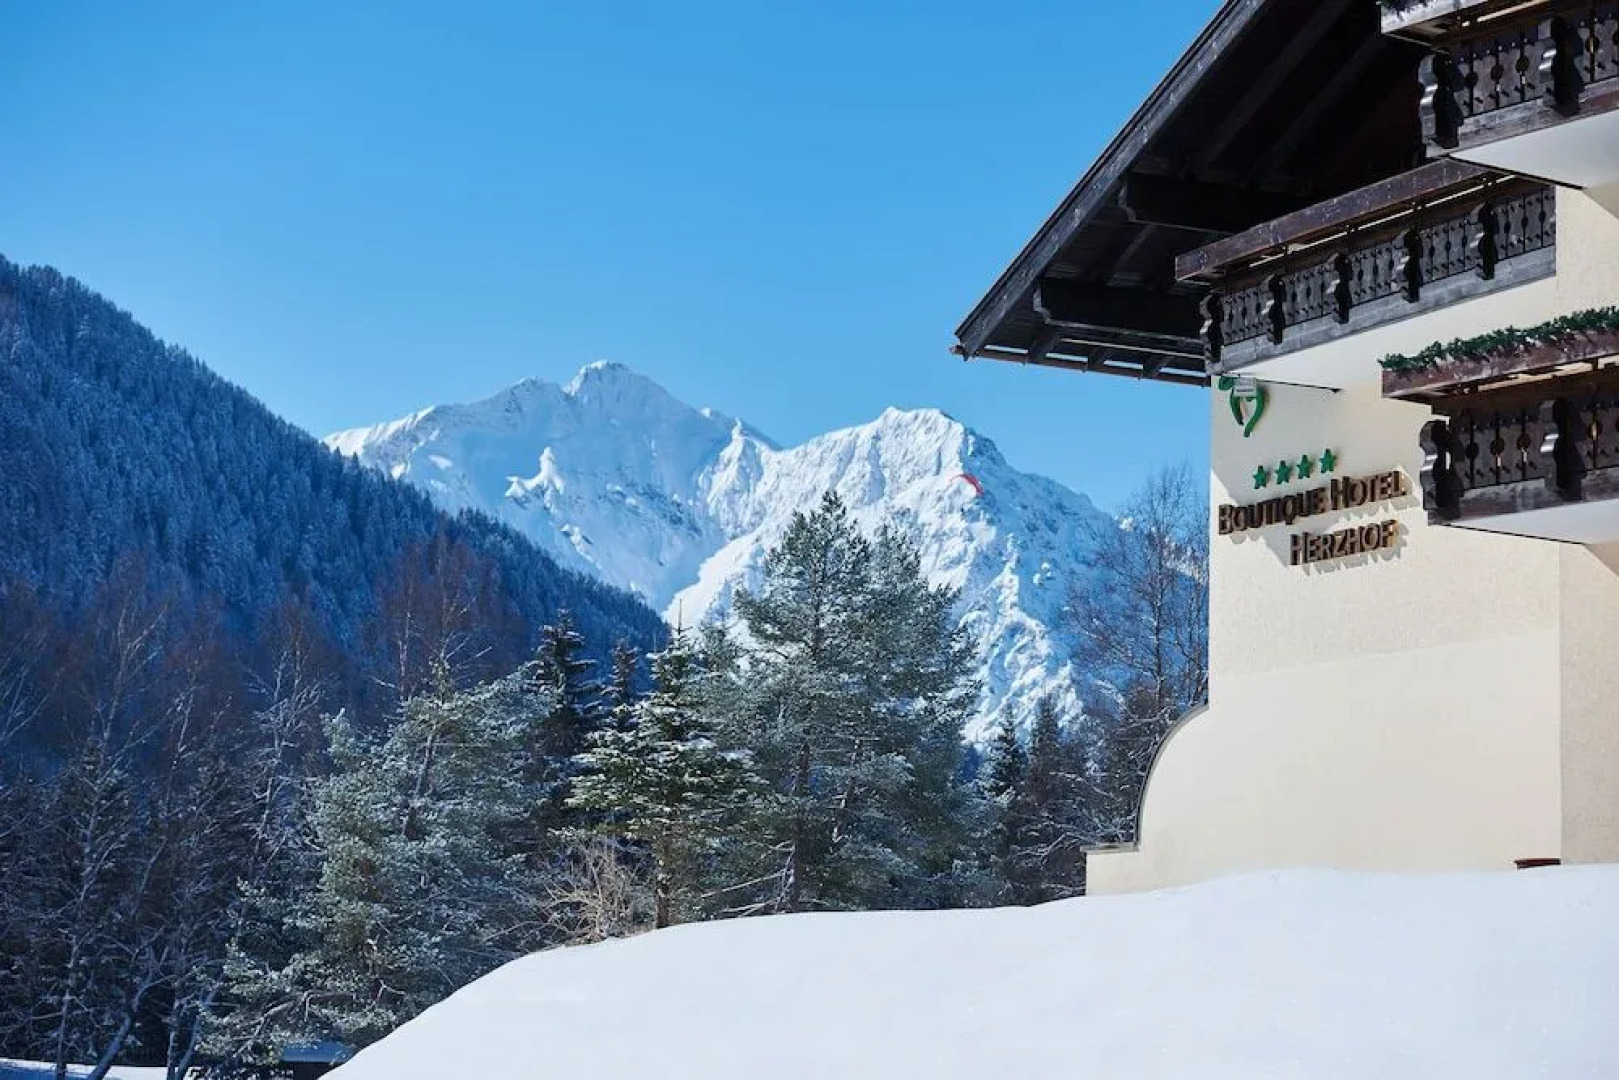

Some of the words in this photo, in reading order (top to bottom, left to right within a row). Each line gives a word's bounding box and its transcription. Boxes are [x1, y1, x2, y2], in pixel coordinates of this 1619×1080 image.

[1218, 486, 1326, 535] BOUTIQUE
[1330, 470, 1407, 511] HOTEL
[1290, 519, 1399, 566] HERZHOF
